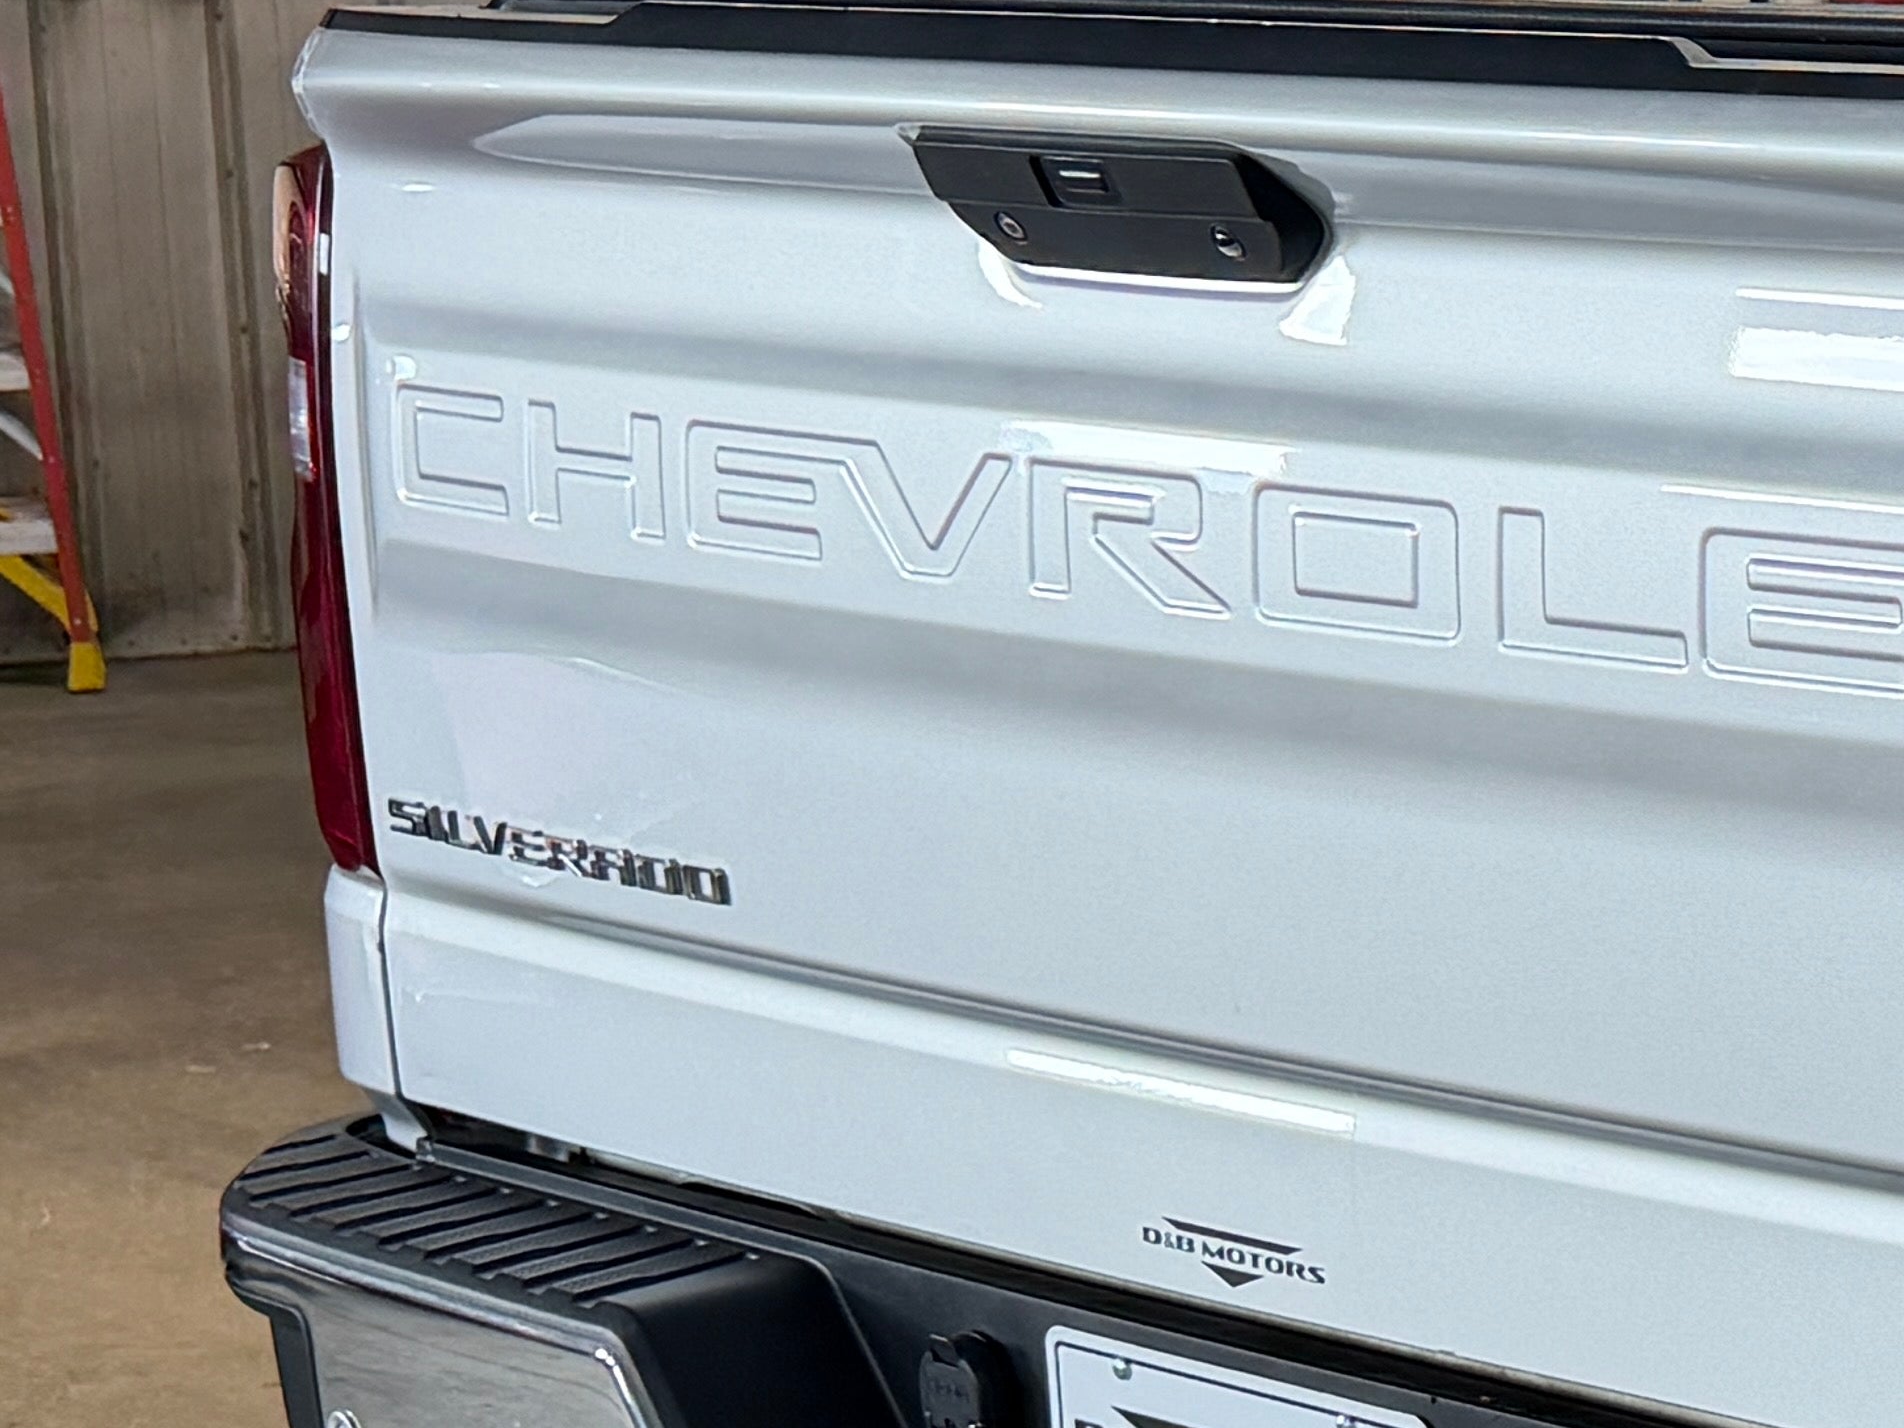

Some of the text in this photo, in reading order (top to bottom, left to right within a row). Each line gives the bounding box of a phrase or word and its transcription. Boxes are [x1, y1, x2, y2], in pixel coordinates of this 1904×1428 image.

[387, 797, 732, 906] SILVERADO
[1142, 1226, 1326, 1284] D&B MOTORS
